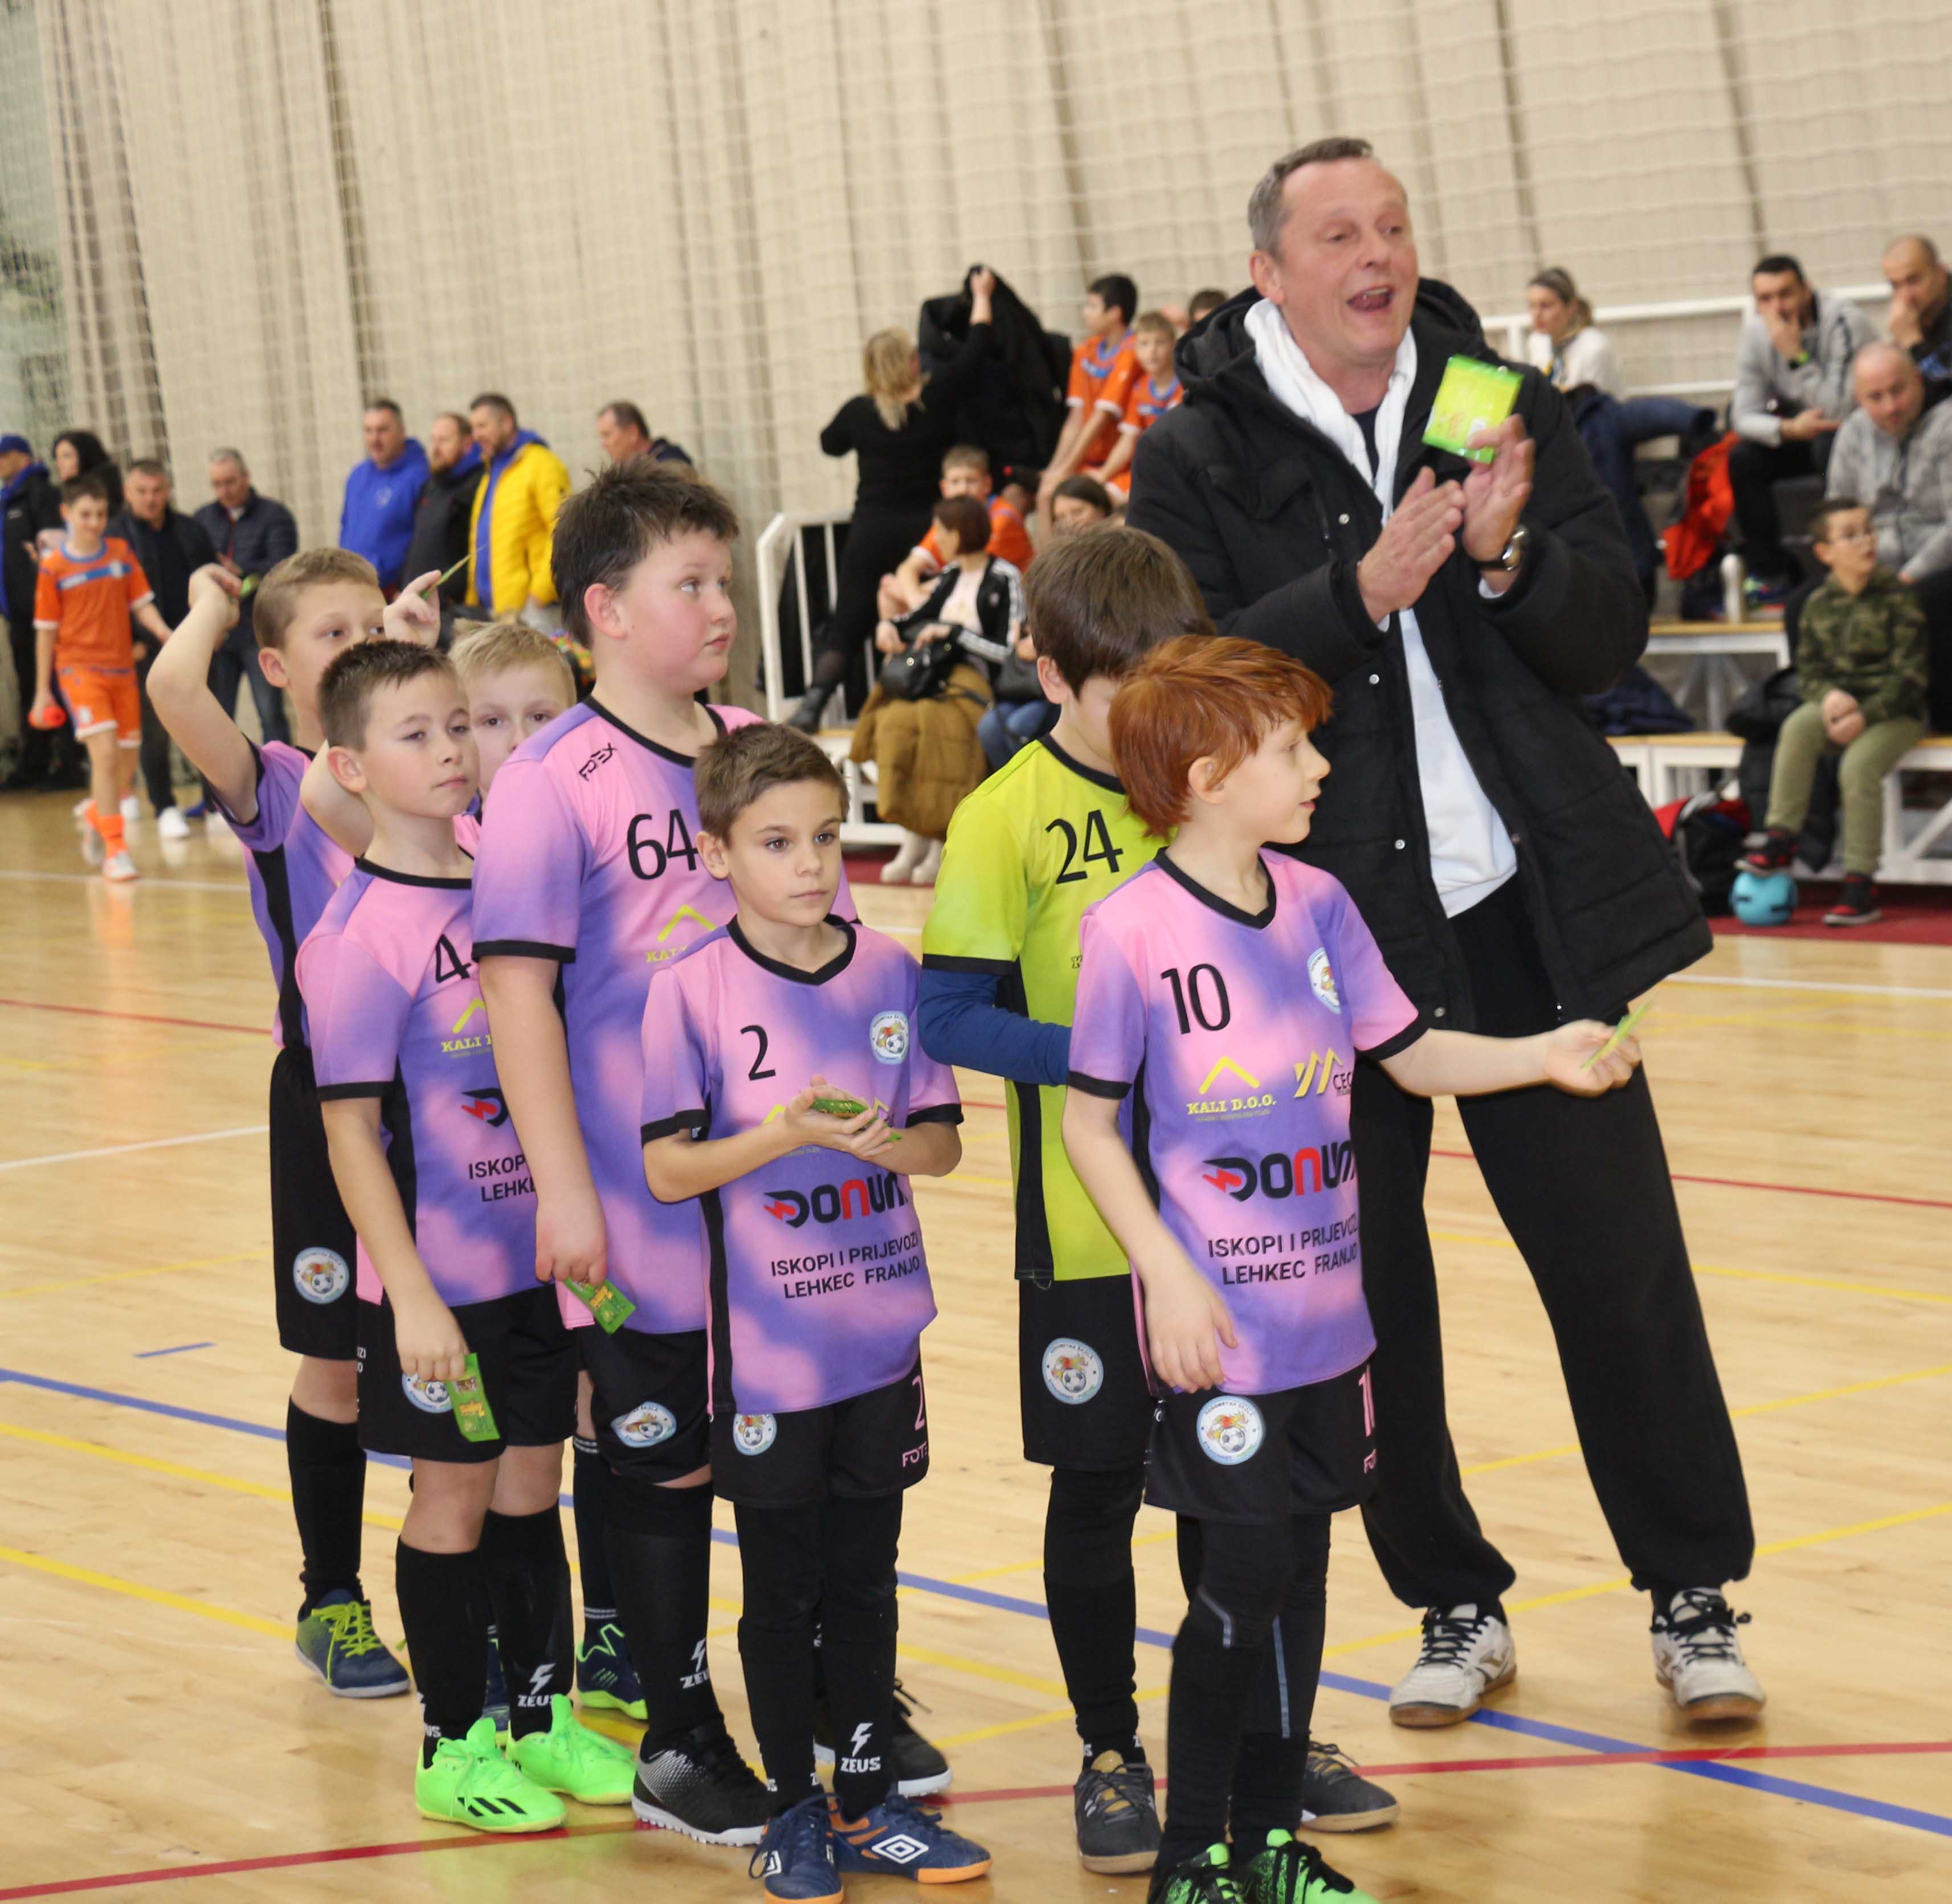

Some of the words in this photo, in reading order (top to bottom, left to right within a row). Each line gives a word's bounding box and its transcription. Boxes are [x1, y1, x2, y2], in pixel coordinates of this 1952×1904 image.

[627, 808, 699, 880] 64
[1045, 810, 1124, 885] 24
[435, 934, 472, 984] 4
[1160, 963, 1231, 1035] 10
[441, 1035, 483, 1053] KALI
[740, 1025, 776, 1081] 2
[1186, 1100, 1228, 1115] KALI
[1231, 1093, 1277, 1112] D.O.O.
[468, 1154, 526, 1180] ISKOP
[481, 1176, 536, 1203] LEHK
[1208, 1235, 1283, 1258] ISKOPI
[1290, 1233, 1294, 1252] I
[771, 1252, 834, 1277] ISKOPI
[839, 1251, 844, 1266] I
[784, 1273, 855, 1299] LEHKEC
[865, 1255, 920, 1284] FRANJO
[1222, 1260, 1306, 1285] LEHKEC
[1314, 1242, 1357, 1276] FRANJO
[912, 1375, 926, 1431] 2
[680, 1669, 709, 1689] ZEU
[517, 1694, 553, 1707] ZEU
[840, 1756, 881, 1774] ZEUS
